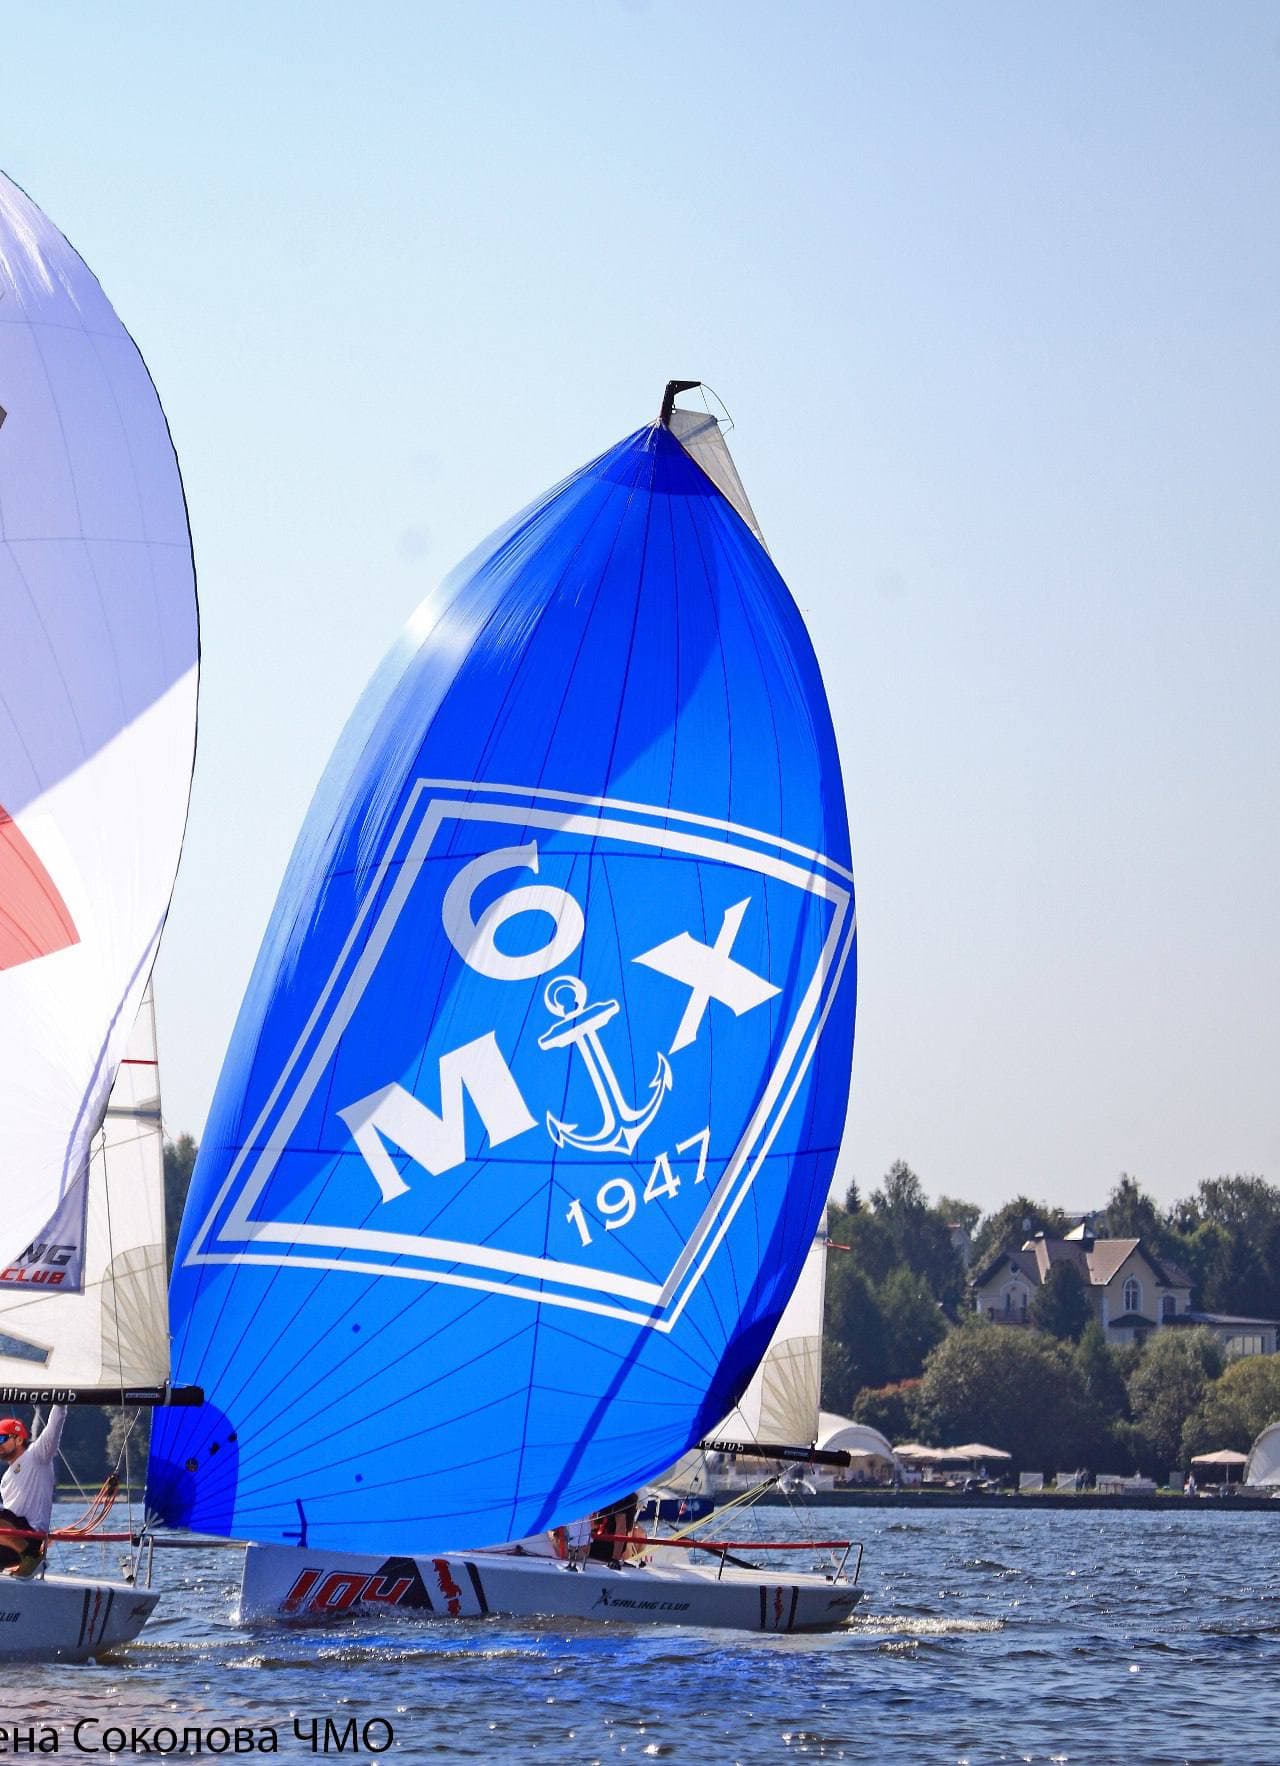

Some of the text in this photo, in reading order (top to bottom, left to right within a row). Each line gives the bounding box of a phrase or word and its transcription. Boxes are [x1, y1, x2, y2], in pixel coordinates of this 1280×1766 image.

[566, 1126, 711, 1246] 1947
[15, 1242, 77, 1265] NG
[0, 1268, 66, 1284] CLUB
[278, 1568, 415, 1614] 104
[610, 1600, 656, 1610] SAILING
[659, 1602, 690, 1611] CLUB
